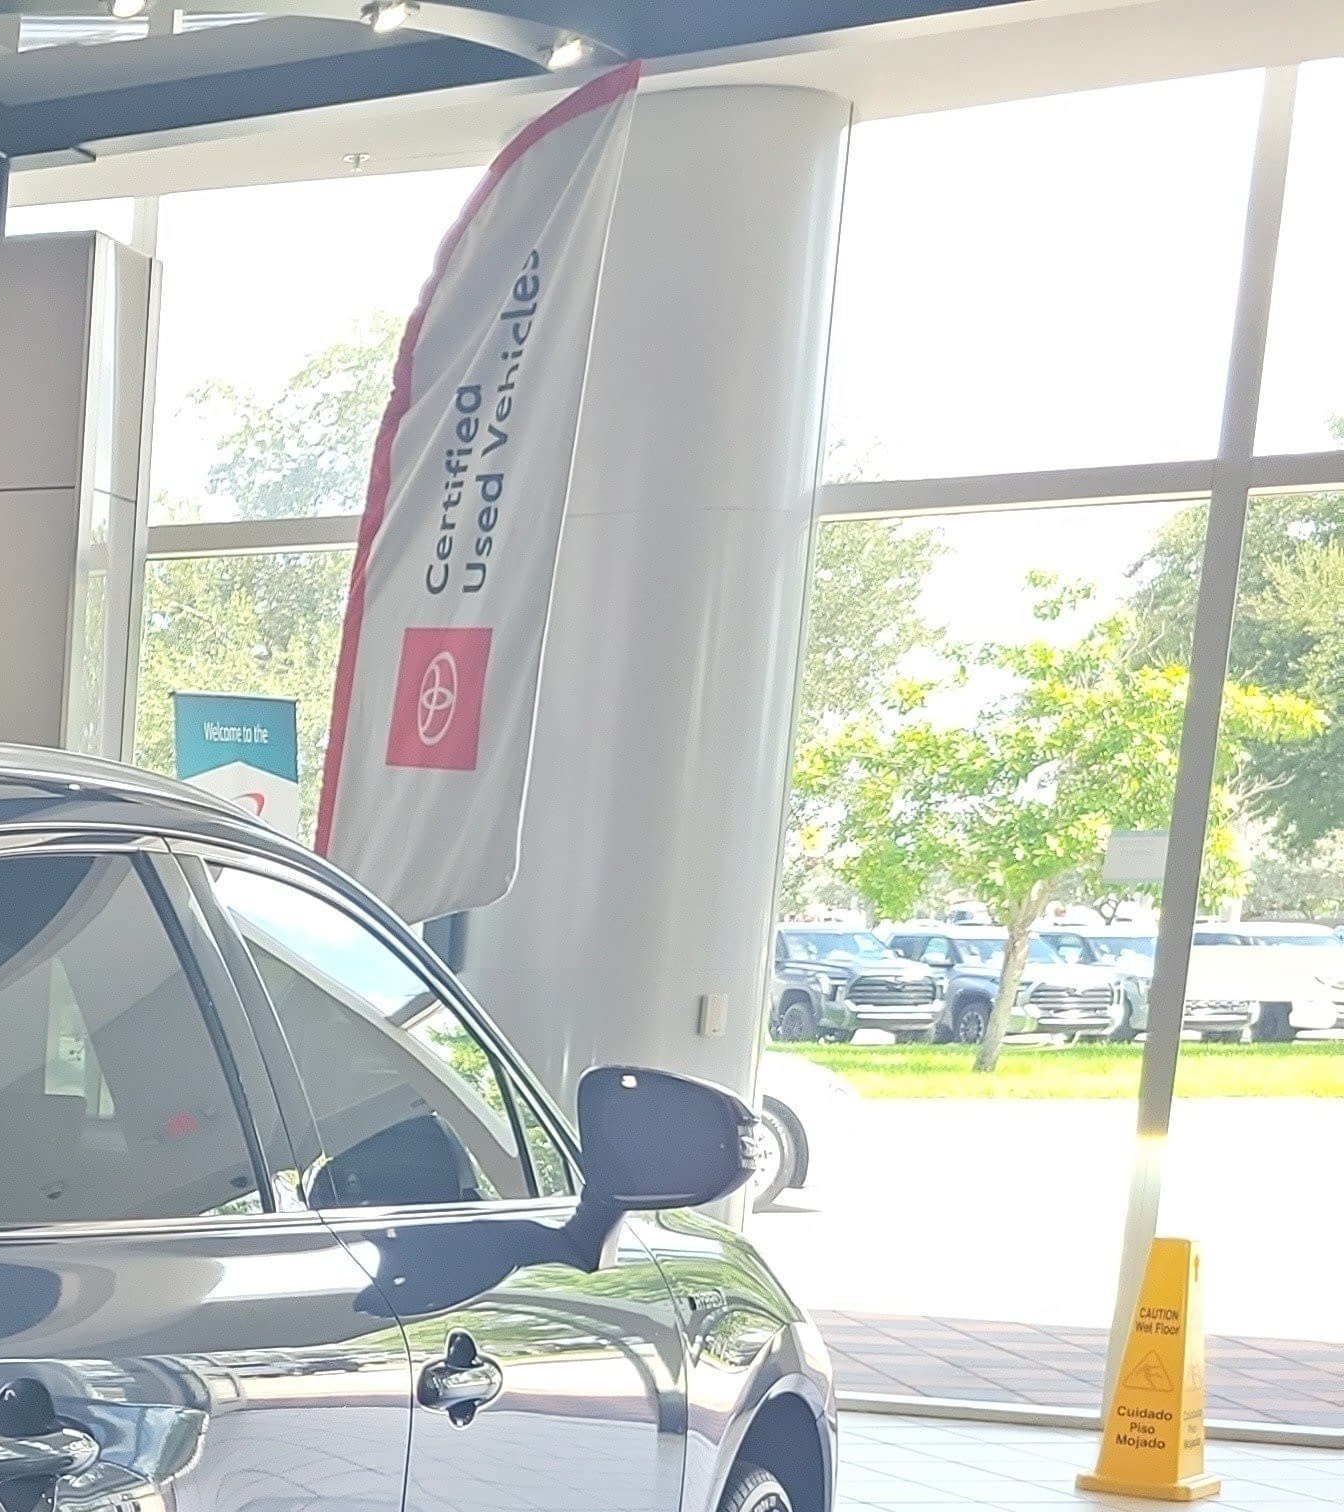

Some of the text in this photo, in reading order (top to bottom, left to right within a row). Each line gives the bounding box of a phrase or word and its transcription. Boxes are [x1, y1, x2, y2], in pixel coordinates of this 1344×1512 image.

[462, 249, 541, 594] Used Vehicles
[426, 383, 482, 595] Certified
[203, 721, 269, 744] Welcome to the
[1139, 1307, 1179, 1320] CAUTION
[1135, 1321, 1180, 1335] Wet Floor
[1116, 1405, 1173, 1421] Cuidado
[1129, 1422, 1155, 1435] Piso
[1115, 1434, 1166, 1449] Mojado
